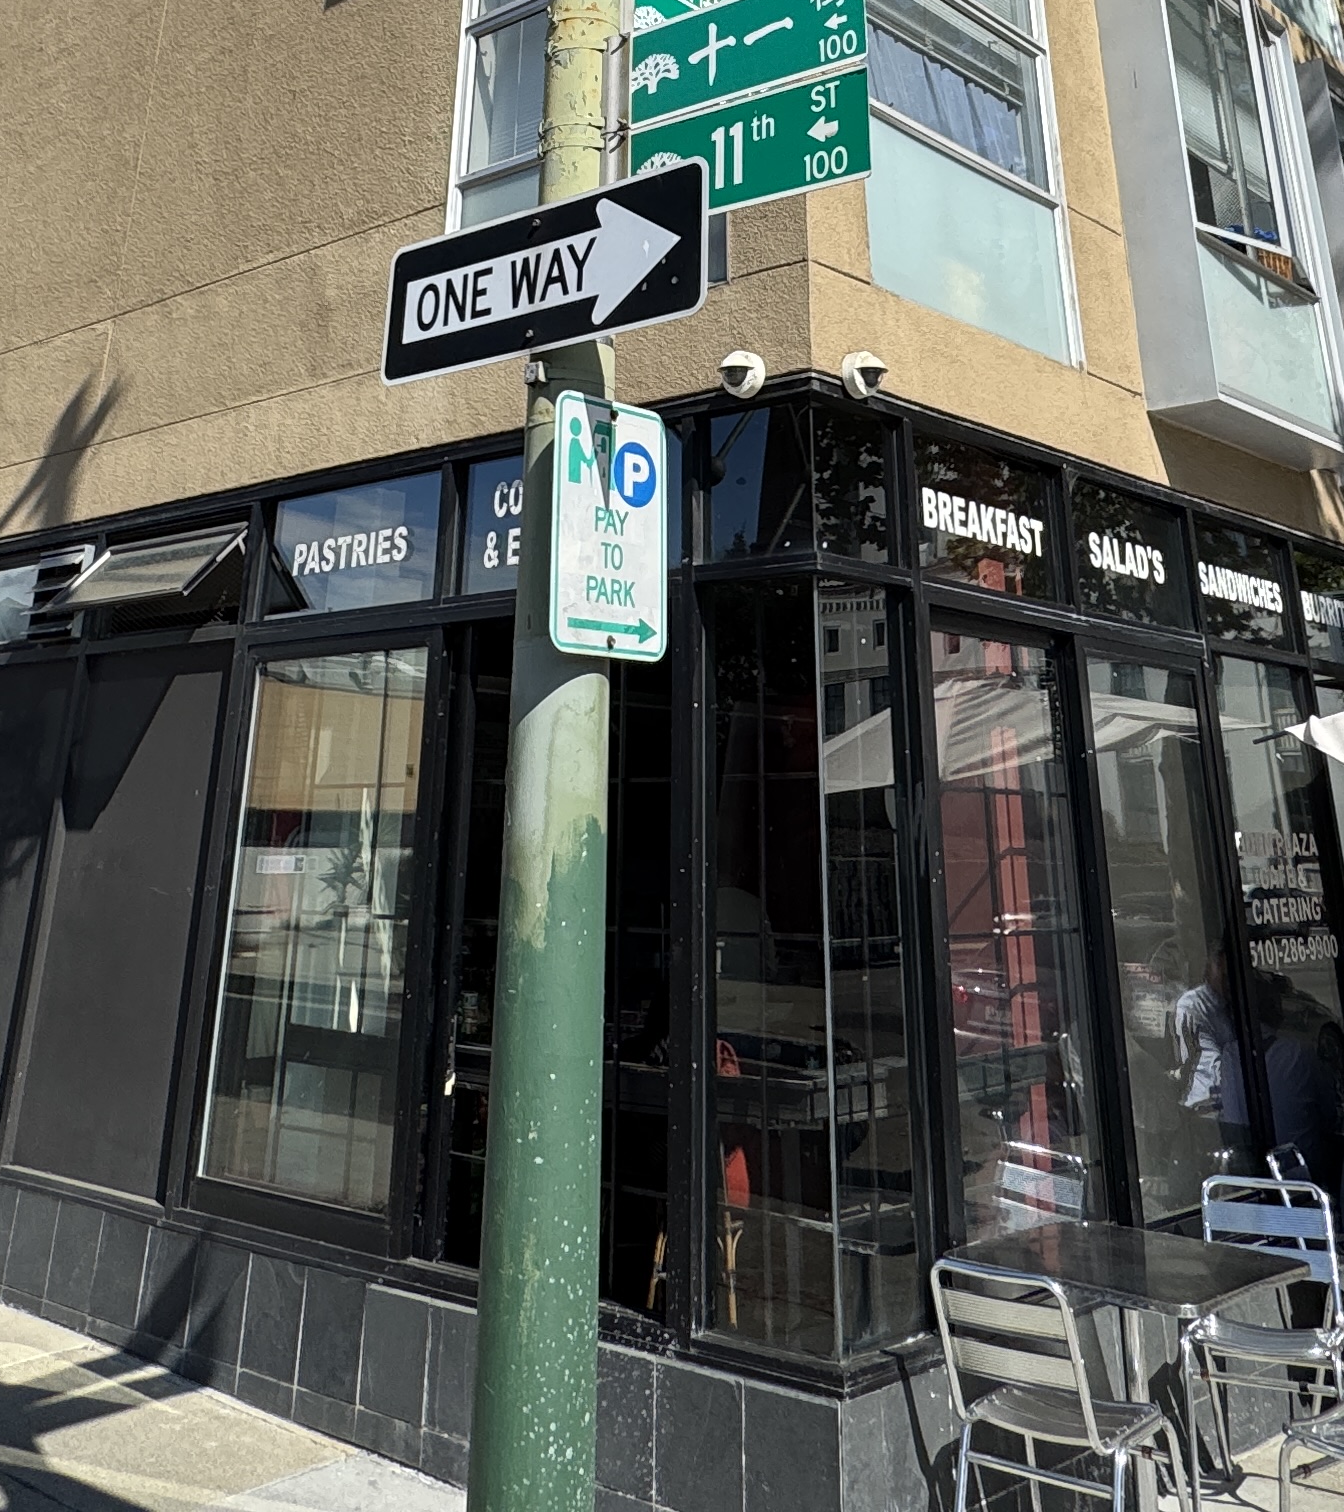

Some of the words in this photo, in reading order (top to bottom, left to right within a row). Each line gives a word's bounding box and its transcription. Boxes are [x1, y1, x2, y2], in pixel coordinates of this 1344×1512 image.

[818, 30, 857, 62] 100
[711, 114, 775, 189] 11th
[810, 80, 840, 112] ST
[804, 146, 847, 181] 100
[417, 266, 493, 332] ONE
[511, 236, 598, 310] WAY
[622, 453, 650, 497] P
[594, 507, 630, 536] PAY
[922, 487, 1044, 557] BREAKFAST
[292, 525, 408, 577] PASTRIES
[601, 542, 623, 571] TO
[1088, 532, 1165, 585] SALAD'S
[585, 574, 636, 608] PARK
[1198, 561, 1283, 613] SANDWICHES
[1251, 896, 1322, 925] CATERING
